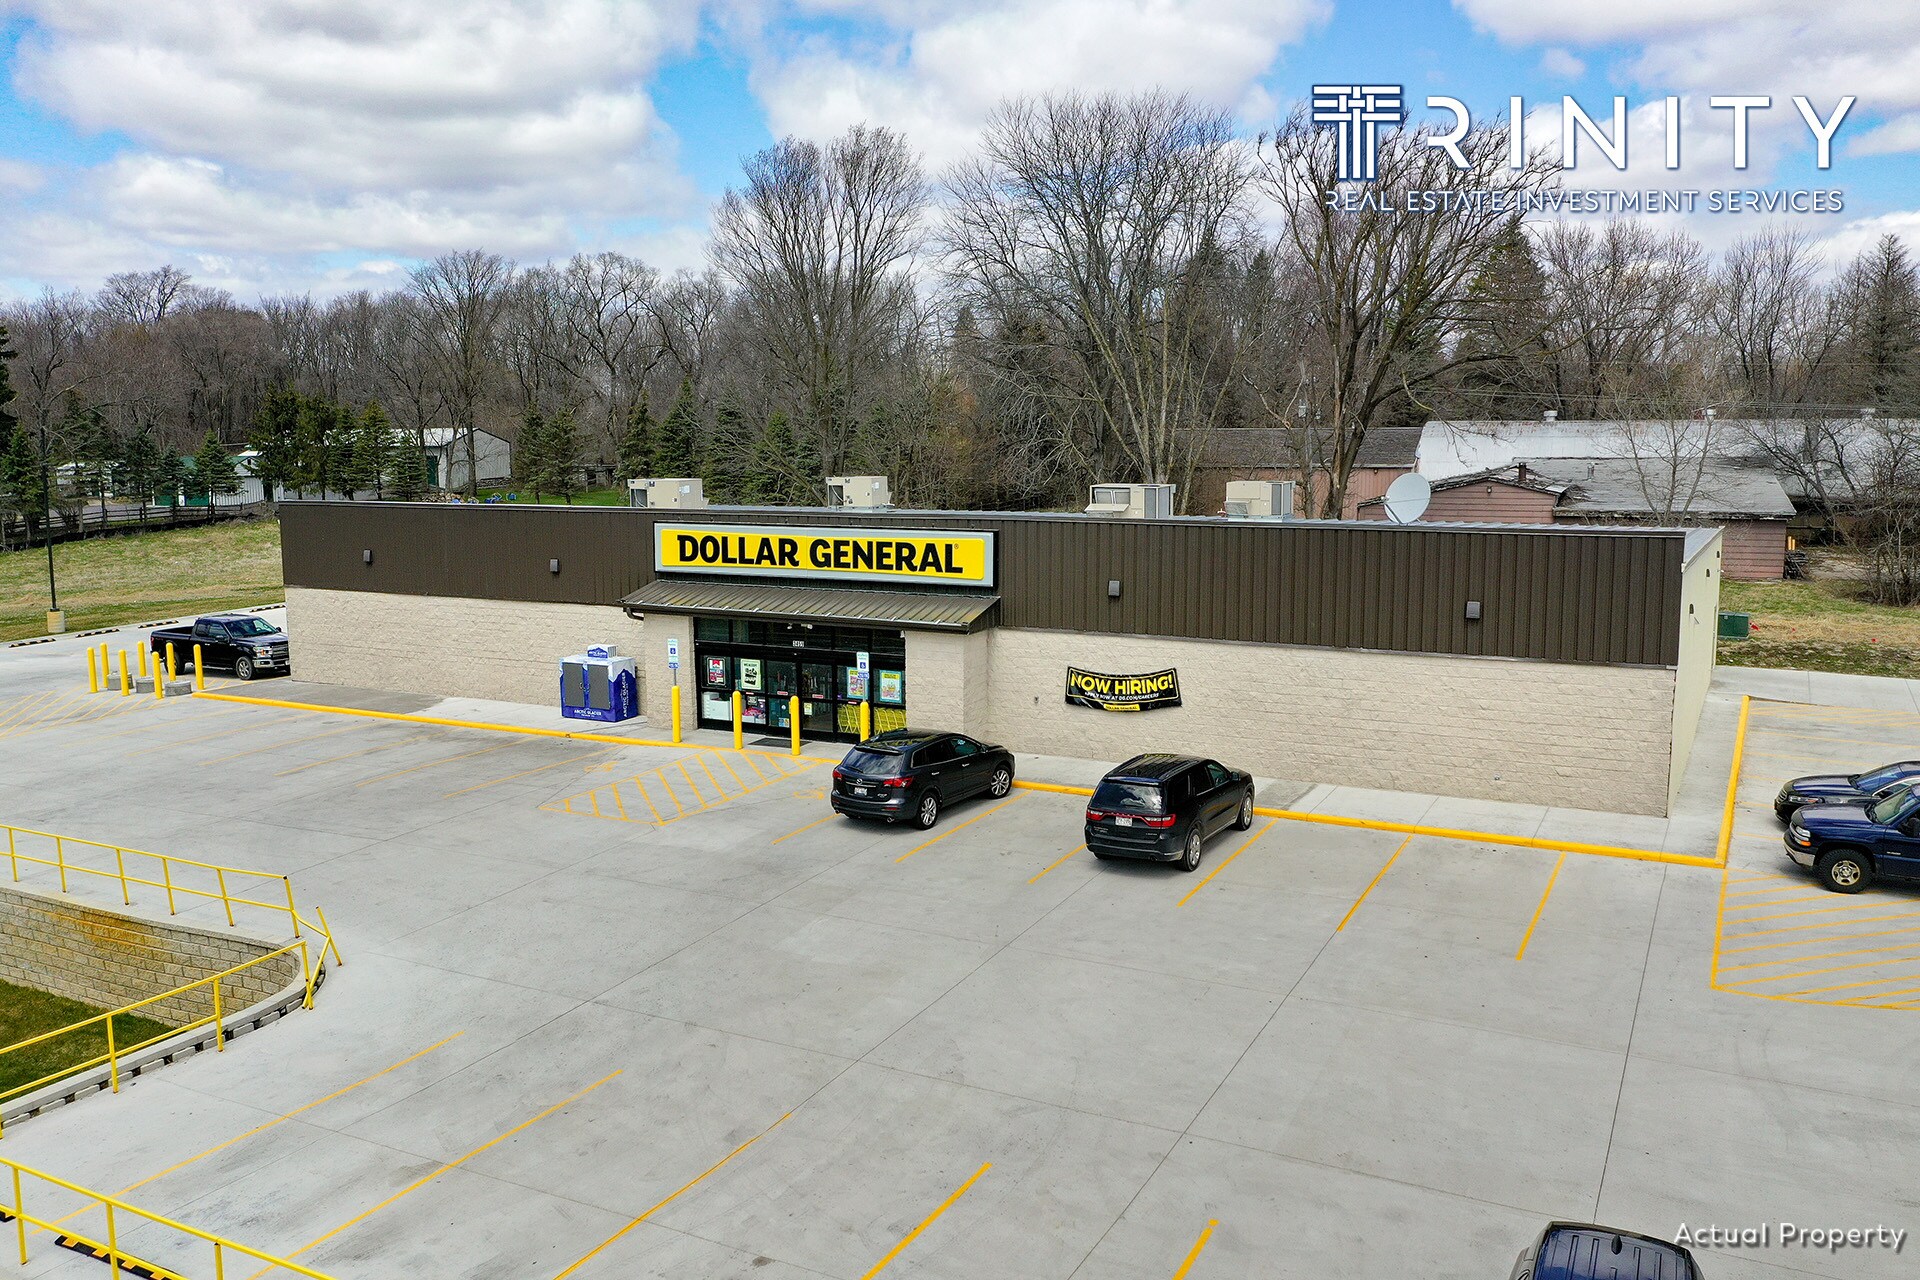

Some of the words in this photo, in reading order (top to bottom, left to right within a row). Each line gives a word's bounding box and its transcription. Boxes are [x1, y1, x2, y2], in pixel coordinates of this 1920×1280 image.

[677, 533, 800, 568] DOLLAR
[808, 539, 964, 574] GENERAL
[1070, 672, 1111, 694] NOW
[1114, 674, 1174, 695] HIRING!
